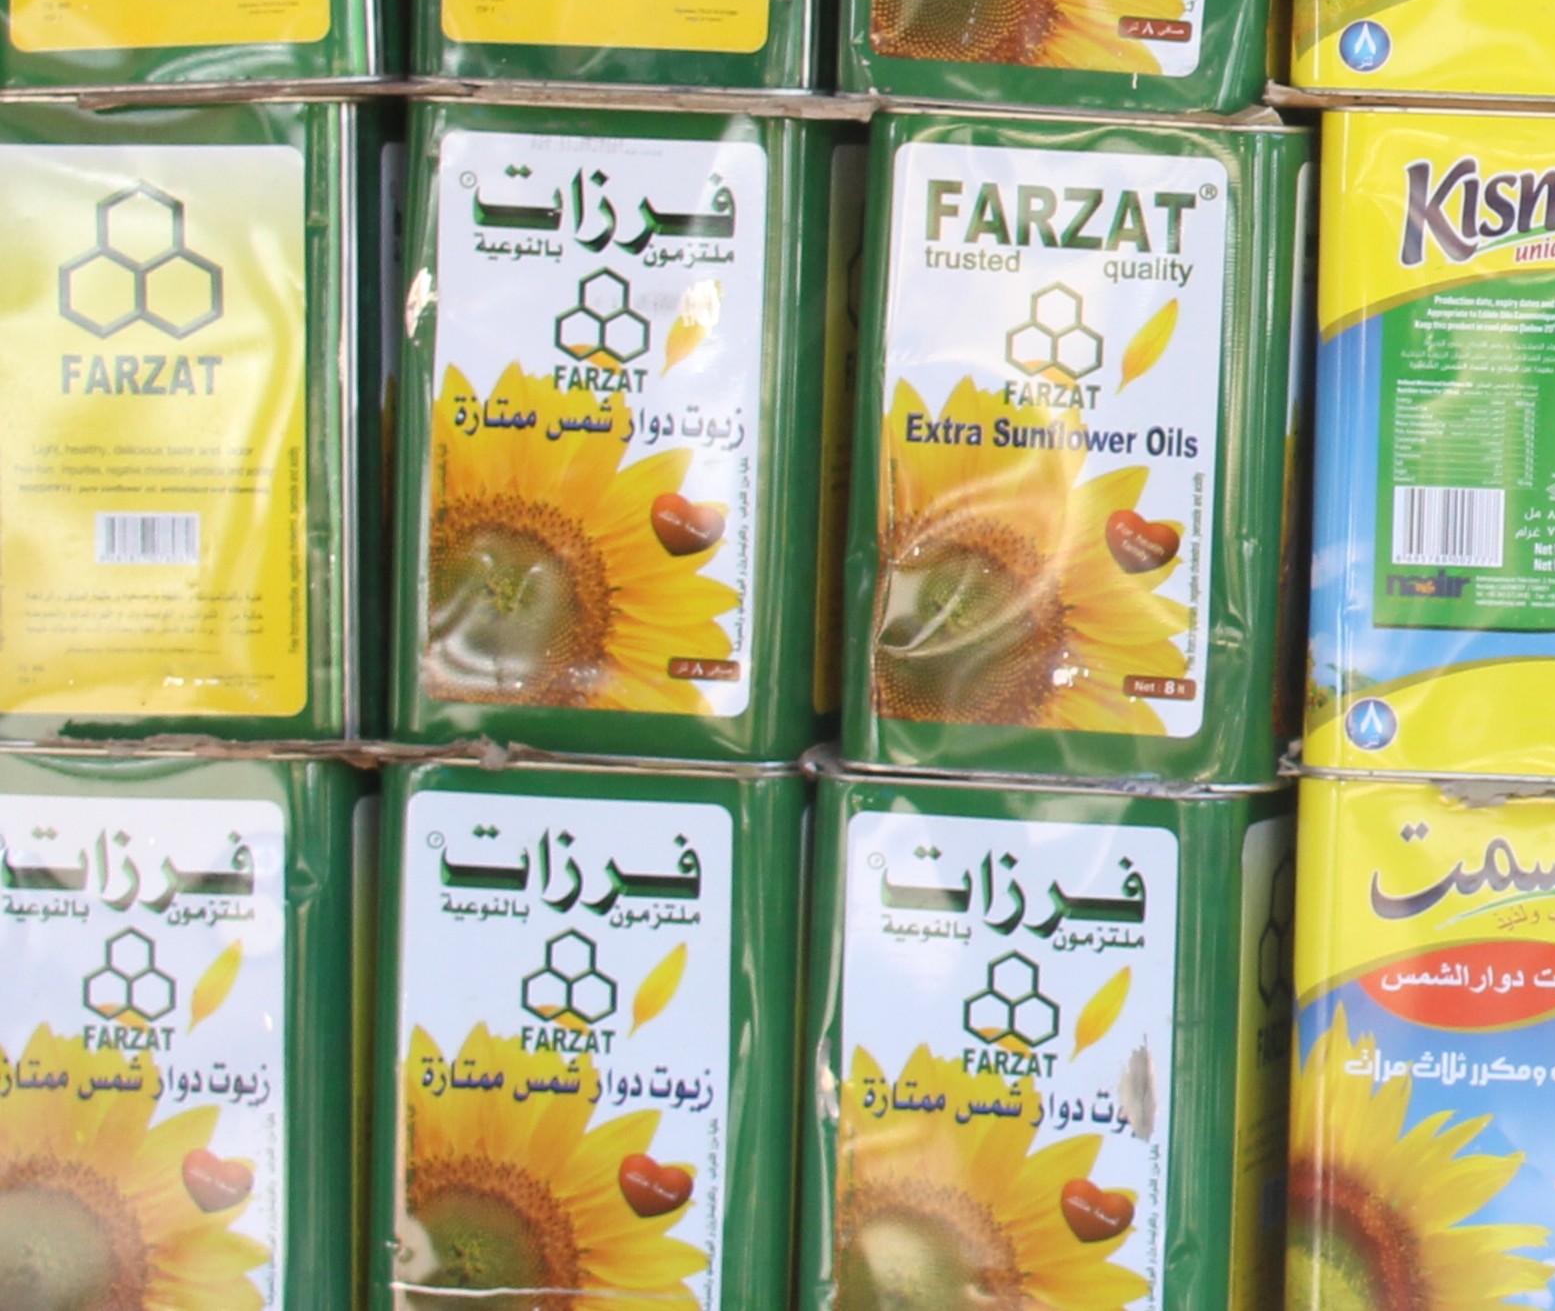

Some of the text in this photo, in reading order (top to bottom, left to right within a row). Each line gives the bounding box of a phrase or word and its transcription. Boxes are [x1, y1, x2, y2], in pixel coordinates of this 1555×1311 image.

[473, 164, 737, 256] فرزات
[925, 179, 1197, 255] FARZAT
[924, 245, 1195, 288] trusted quality
[61, 354, 224, 397] FARZAT
[553, 365, 649, 394] FARZAT
[1003, 380, 1102, 410] FARZAT
[454, 395, 746, 452] زيوت دوار شمس ممتازة
[906, 411, 1199, 460] Extra Sunflower Oils
[1134, 681, 1155, 693] Net
[439, 824, 702, 916] فرزات
[881, 844, 1147, 939] فرزات
[440, 893, 702, 930] ملتزمون بالنوعية
[1380, 962, 1470, 991] الشمس
[1472, 965, 1525, 987] دوار
[82, 1026, 175, 1052] FARZAT
[520, 1025, 615, 1054] FARZAT
[962, 1048, 1059, 1080] FARZAT
